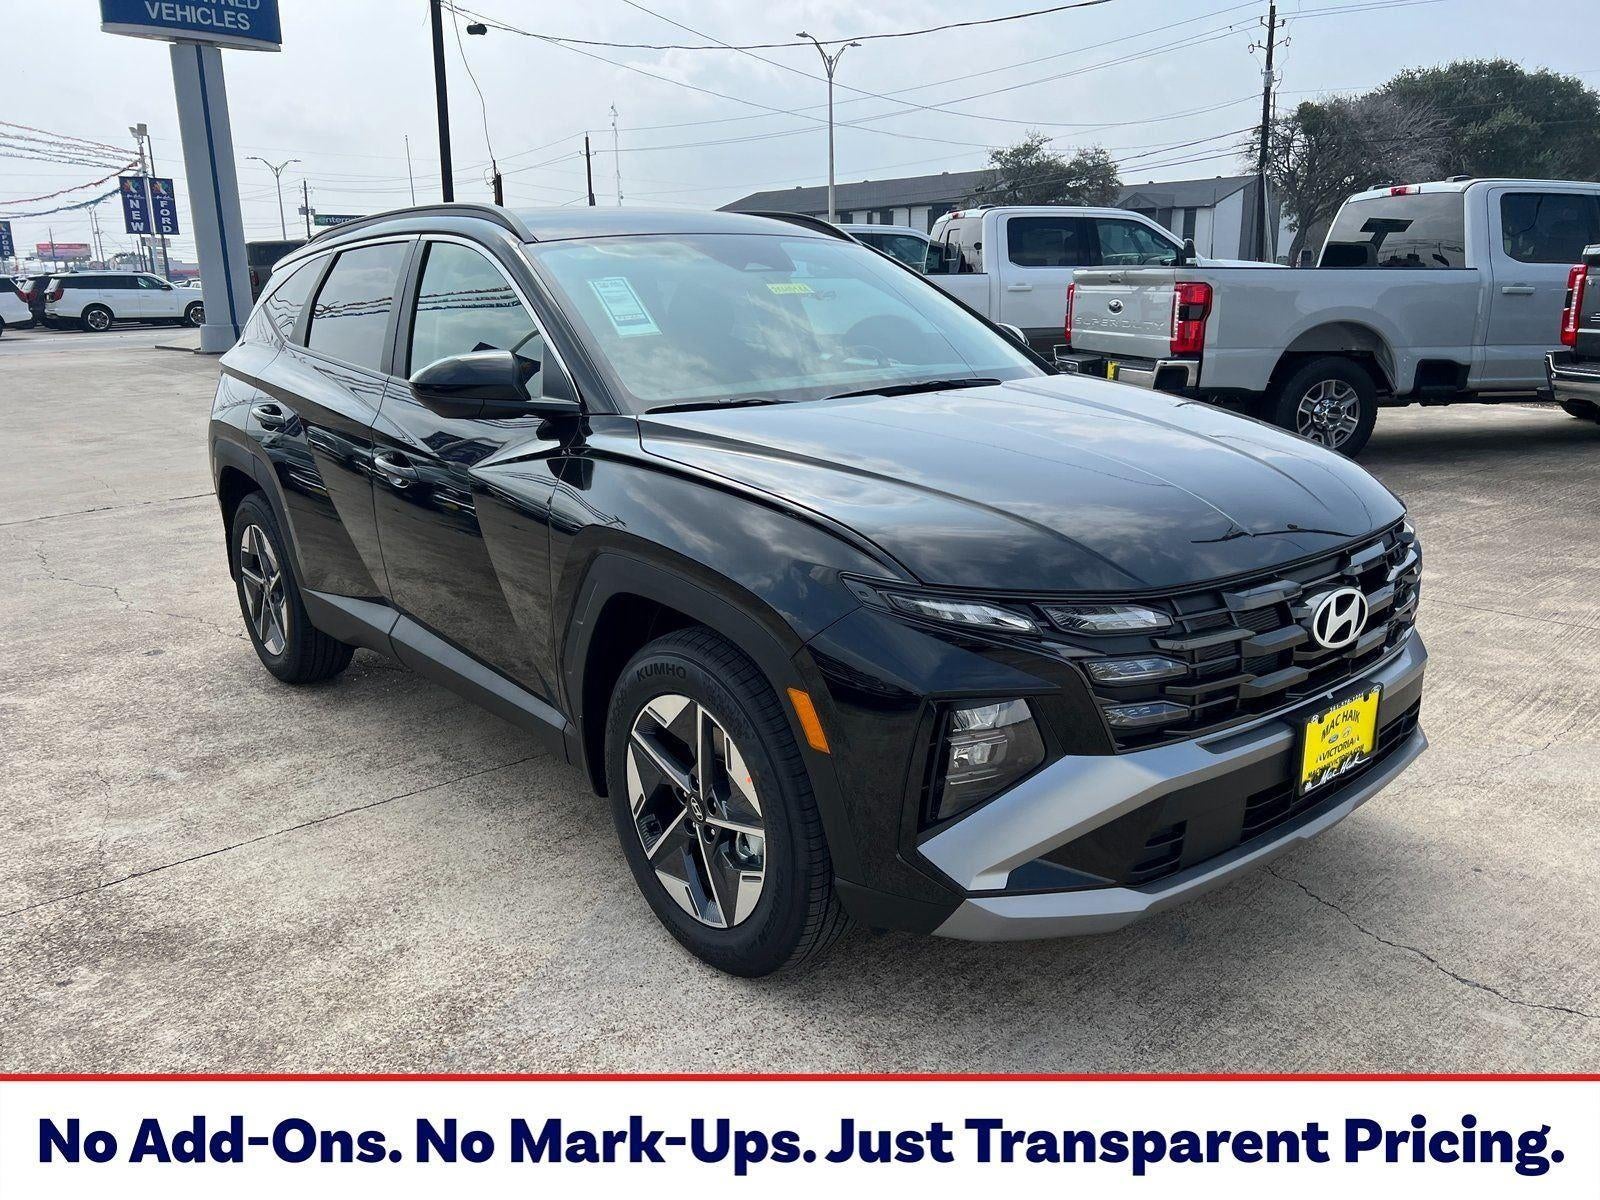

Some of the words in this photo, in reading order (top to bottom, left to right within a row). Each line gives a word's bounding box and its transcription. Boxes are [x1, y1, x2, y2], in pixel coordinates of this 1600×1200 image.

[145, 1, 251, 31] VEHICLES
[130, 200, 144, 232] NEW
[160, 200, 172, 233] FORD
[636, 662, 687, 682] KUMHO
[1321, 713, 1341, 742] MAC
[1341, 708, 1361, 723] HAIK
[1322, 737, 1354, 761] VICTORIA
